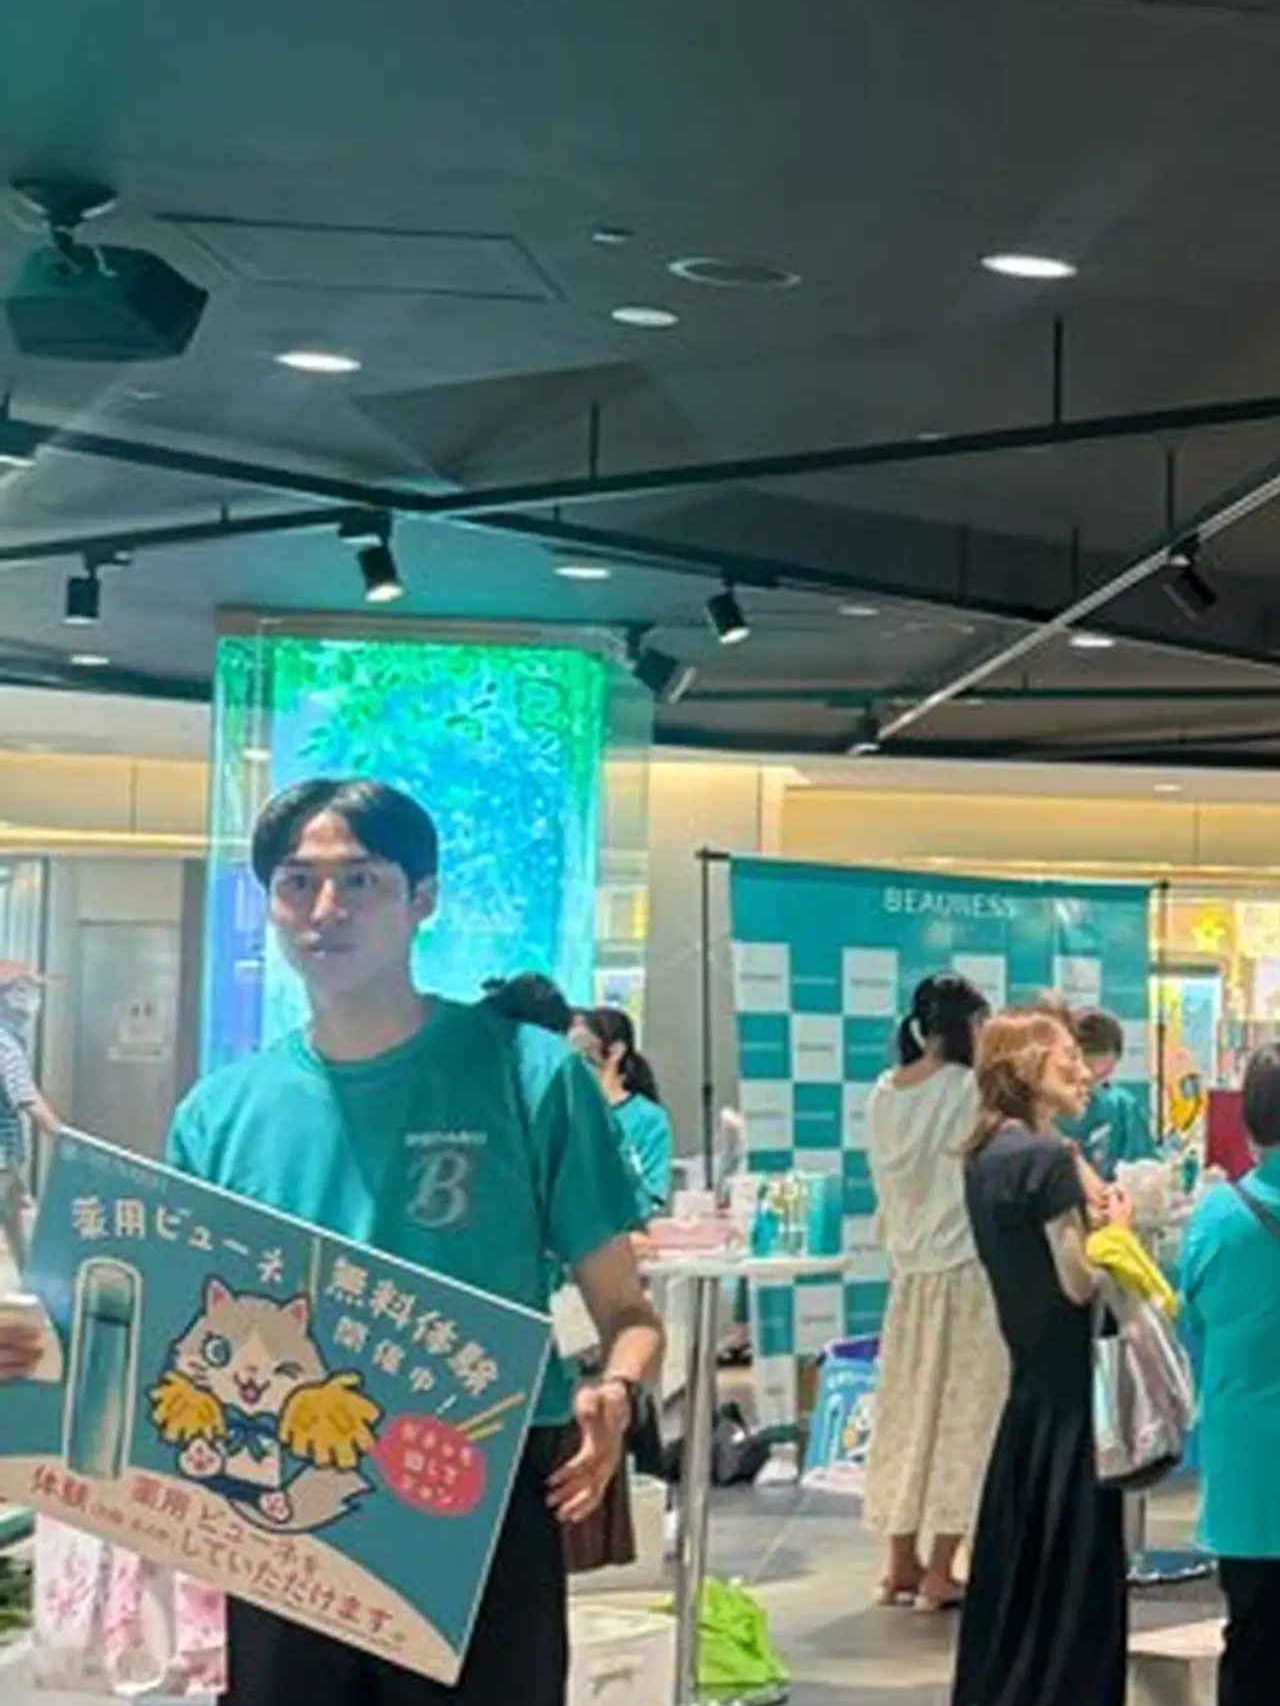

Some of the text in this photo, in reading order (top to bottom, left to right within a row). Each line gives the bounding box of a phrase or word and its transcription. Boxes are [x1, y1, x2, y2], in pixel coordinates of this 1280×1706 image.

[72, 1195, 284, 1283] 薬用ビューネ
[326, 1254, 498, 1397] 無料体験
